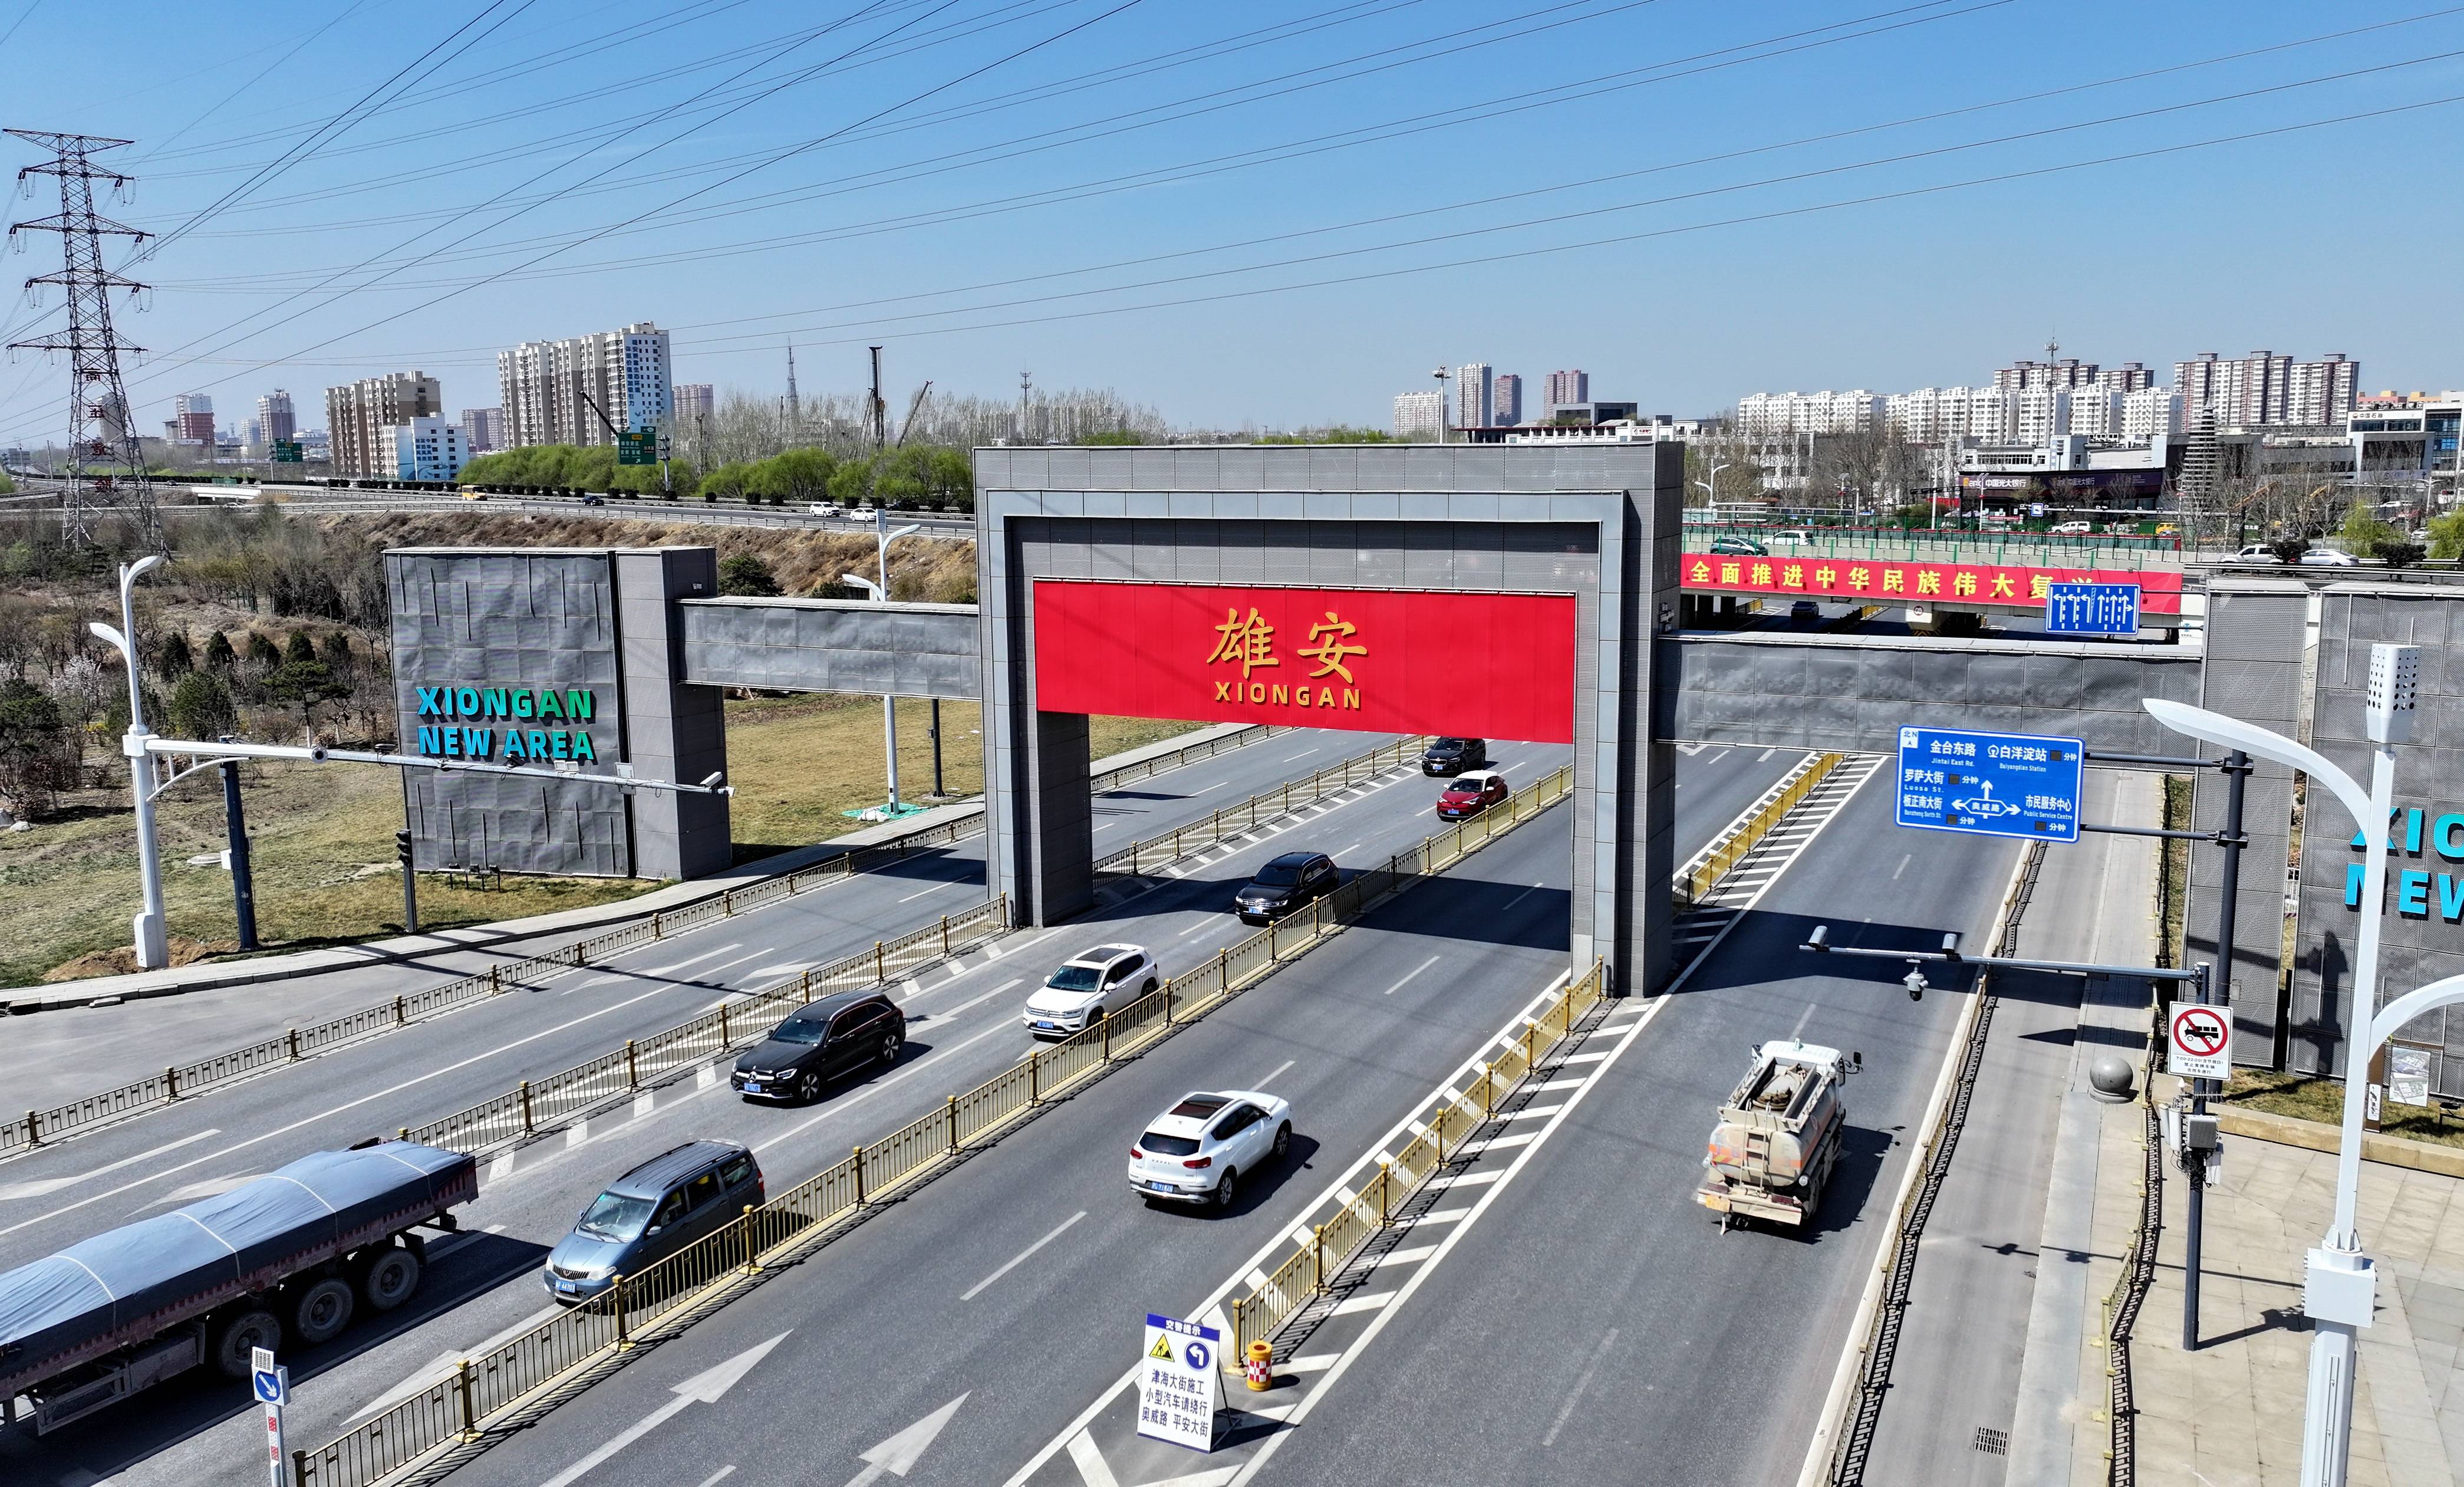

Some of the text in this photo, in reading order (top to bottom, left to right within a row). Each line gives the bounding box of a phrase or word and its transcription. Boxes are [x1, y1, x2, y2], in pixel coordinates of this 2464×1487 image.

[1985, 479, 2027, 487] 中国光大银行
[1207, 607, 1368, 684] 雄安
[415, 687, 591, 718] XIONGAN
[1215, 682, 1360, 709] XIONGAN
[418, 726, 594, 759] NEW AREA
[1930, 740, 1976, 756] 金台东路
[2000, 745, 2077, 762] 白洋淀站 分钟
[1904, 769, 1979, 784] 罗萨大街 分钟
[1972, 802, 2000, 812] 奥威路
[2025, 795, 2072, 812] 市民服务中心
[1959, 817, 1976, 825] 分钟
[2049, 823, 2066, 832] 分钟
[1165, 1320, 1201, 1336] 交警提示
[1151, 1368, 1204, 1396] 津海大街施工
[1146, 1387, 1207, 1417] 小型汽车请绕行
[1142, 1406, 1208, 1437] 奥威路 平安大街
